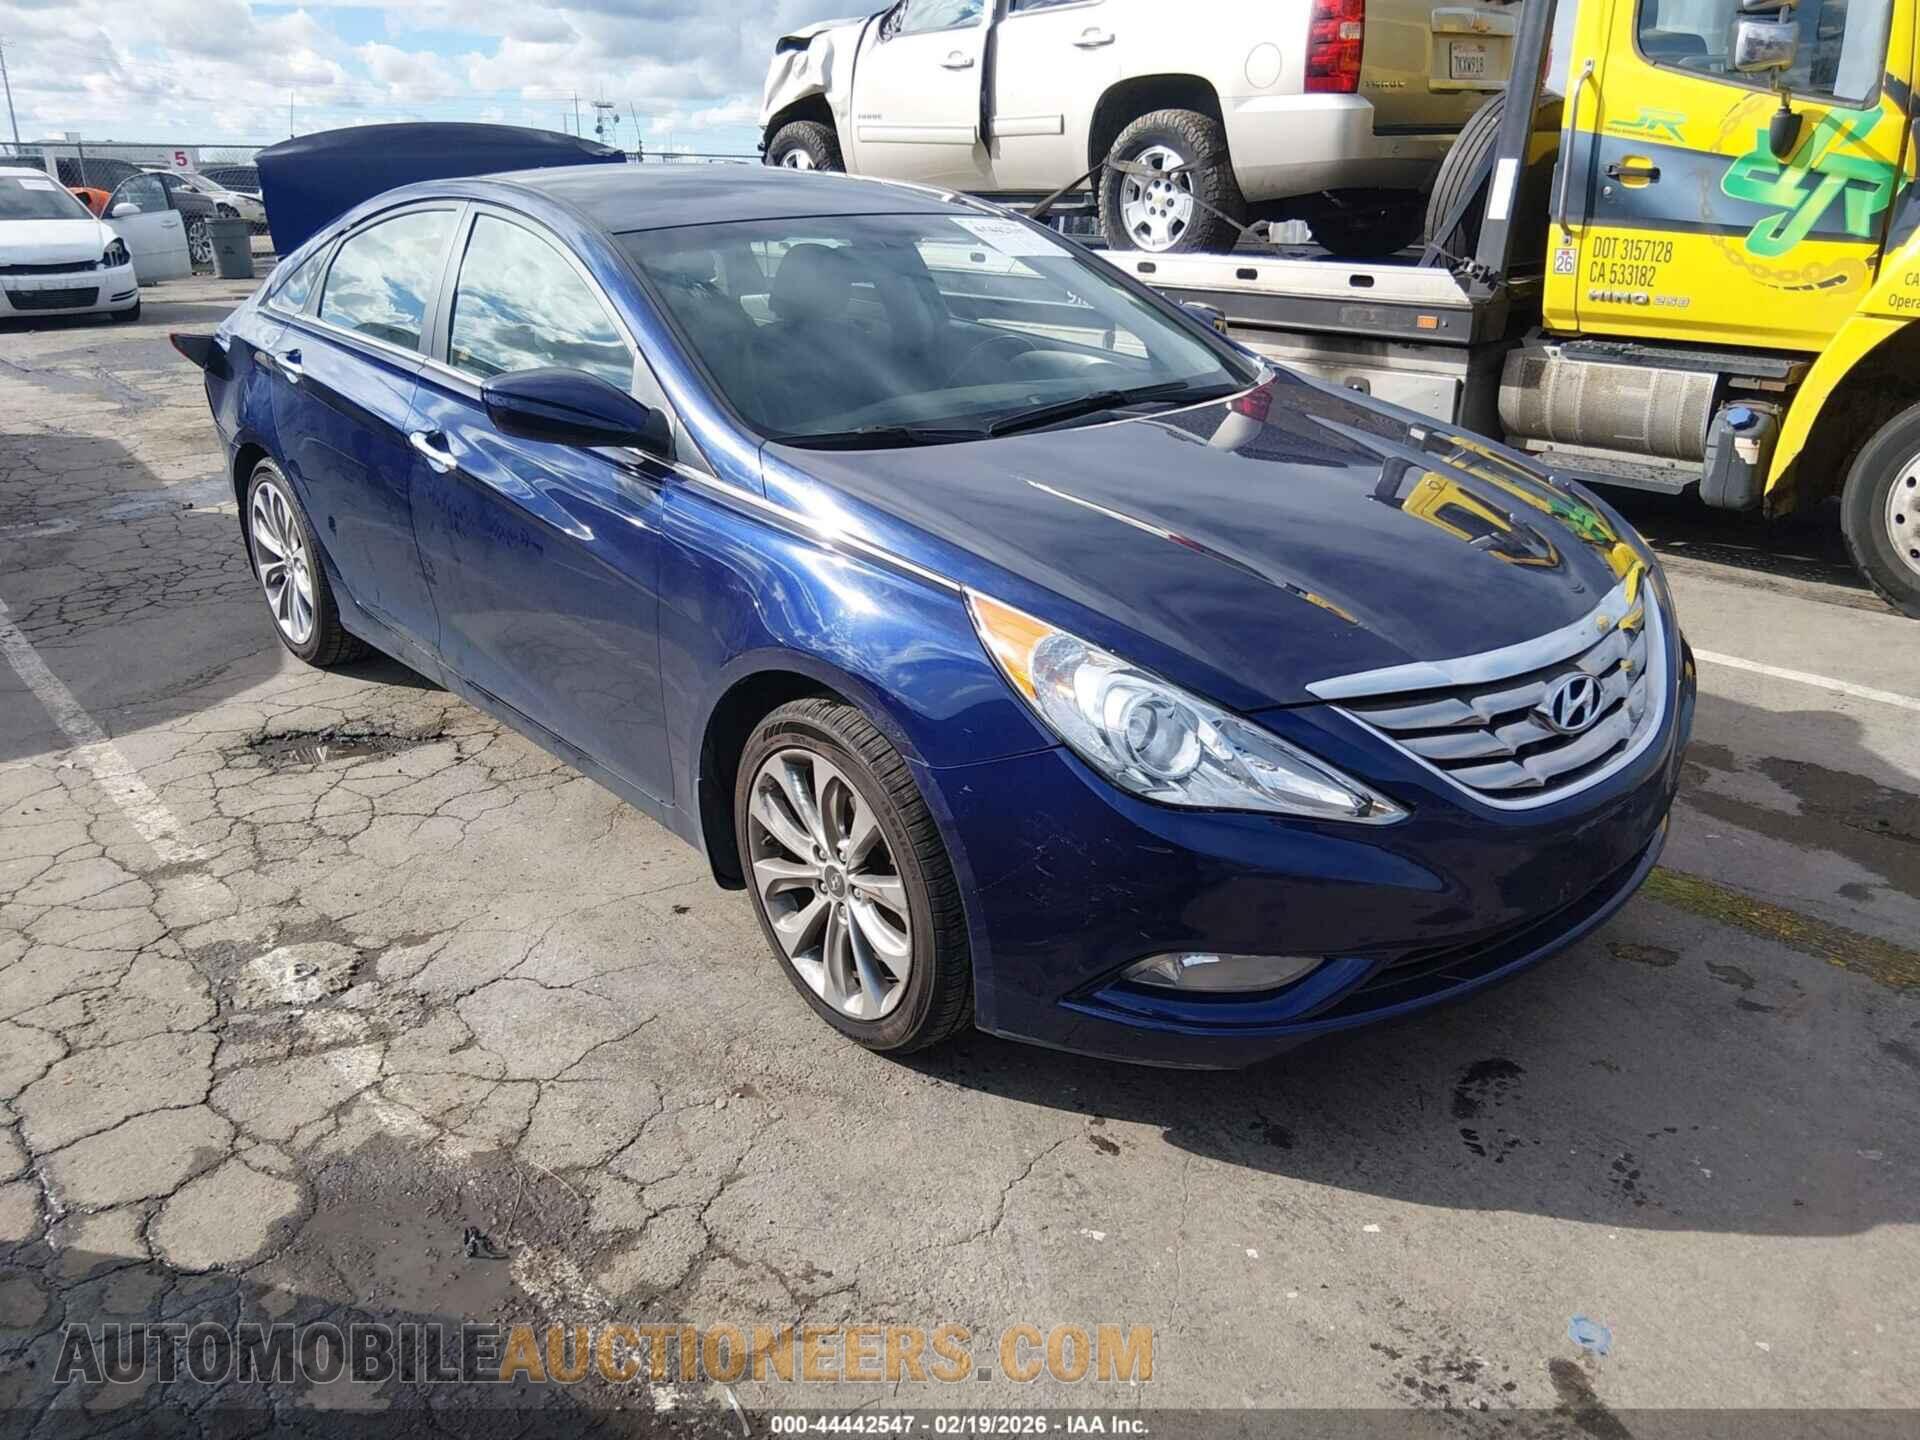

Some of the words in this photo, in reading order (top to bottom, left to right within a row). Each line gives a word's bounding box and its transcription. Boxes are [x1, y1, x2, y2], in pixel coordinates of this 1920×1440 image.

[175, 151, 187, 166] 5
[1592, 236, 1619, 259] DOT
[1620, 238, 1673, 263] 3157128
[1556, 255, 1573, 272] 26
[1589, 261, 1606, 283] CA
[1609, 263, 1656, 287] 533182
